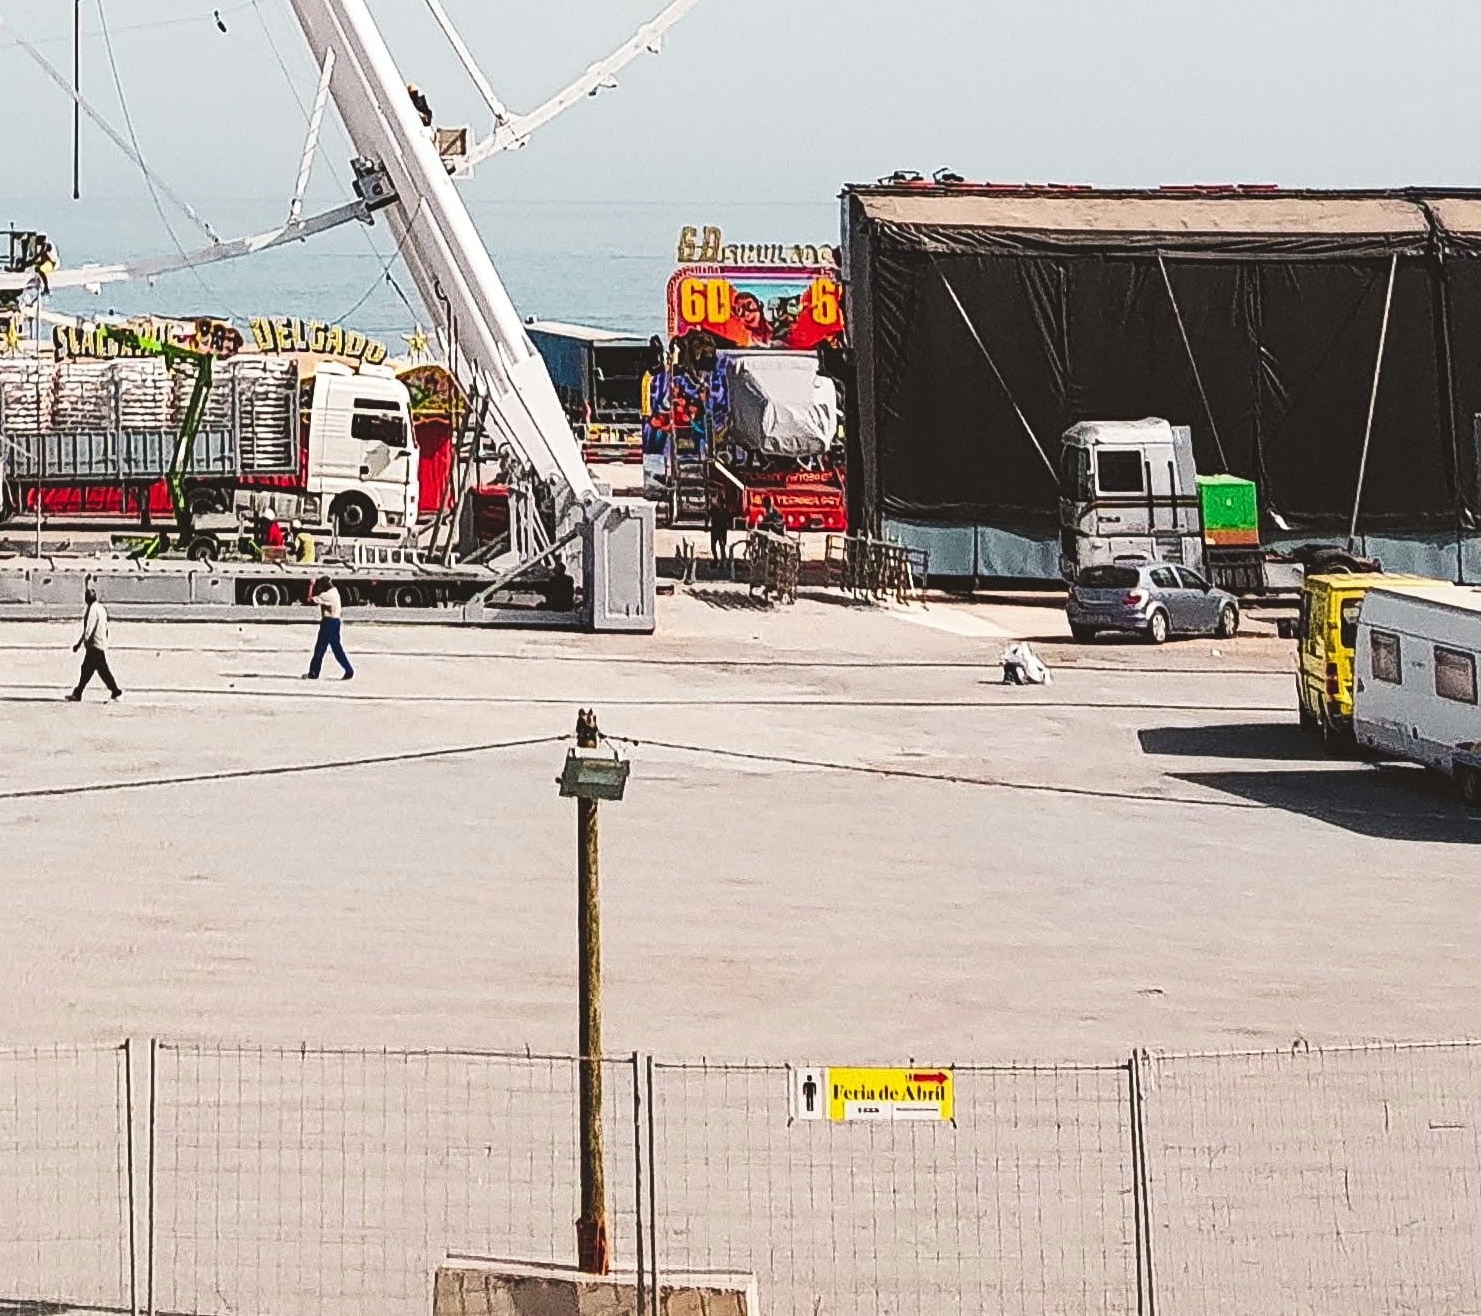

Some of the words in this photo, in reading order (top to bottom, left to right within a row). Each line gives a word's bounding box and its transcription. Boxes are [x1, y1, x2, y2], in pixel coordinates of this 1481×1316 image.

[250, 316, 389, 365] DELGADO
[833, 1083, 875, 1101] Feria
[879, 1084, 899, 1101] de
[902, 1084, 945, 1101] Abril
